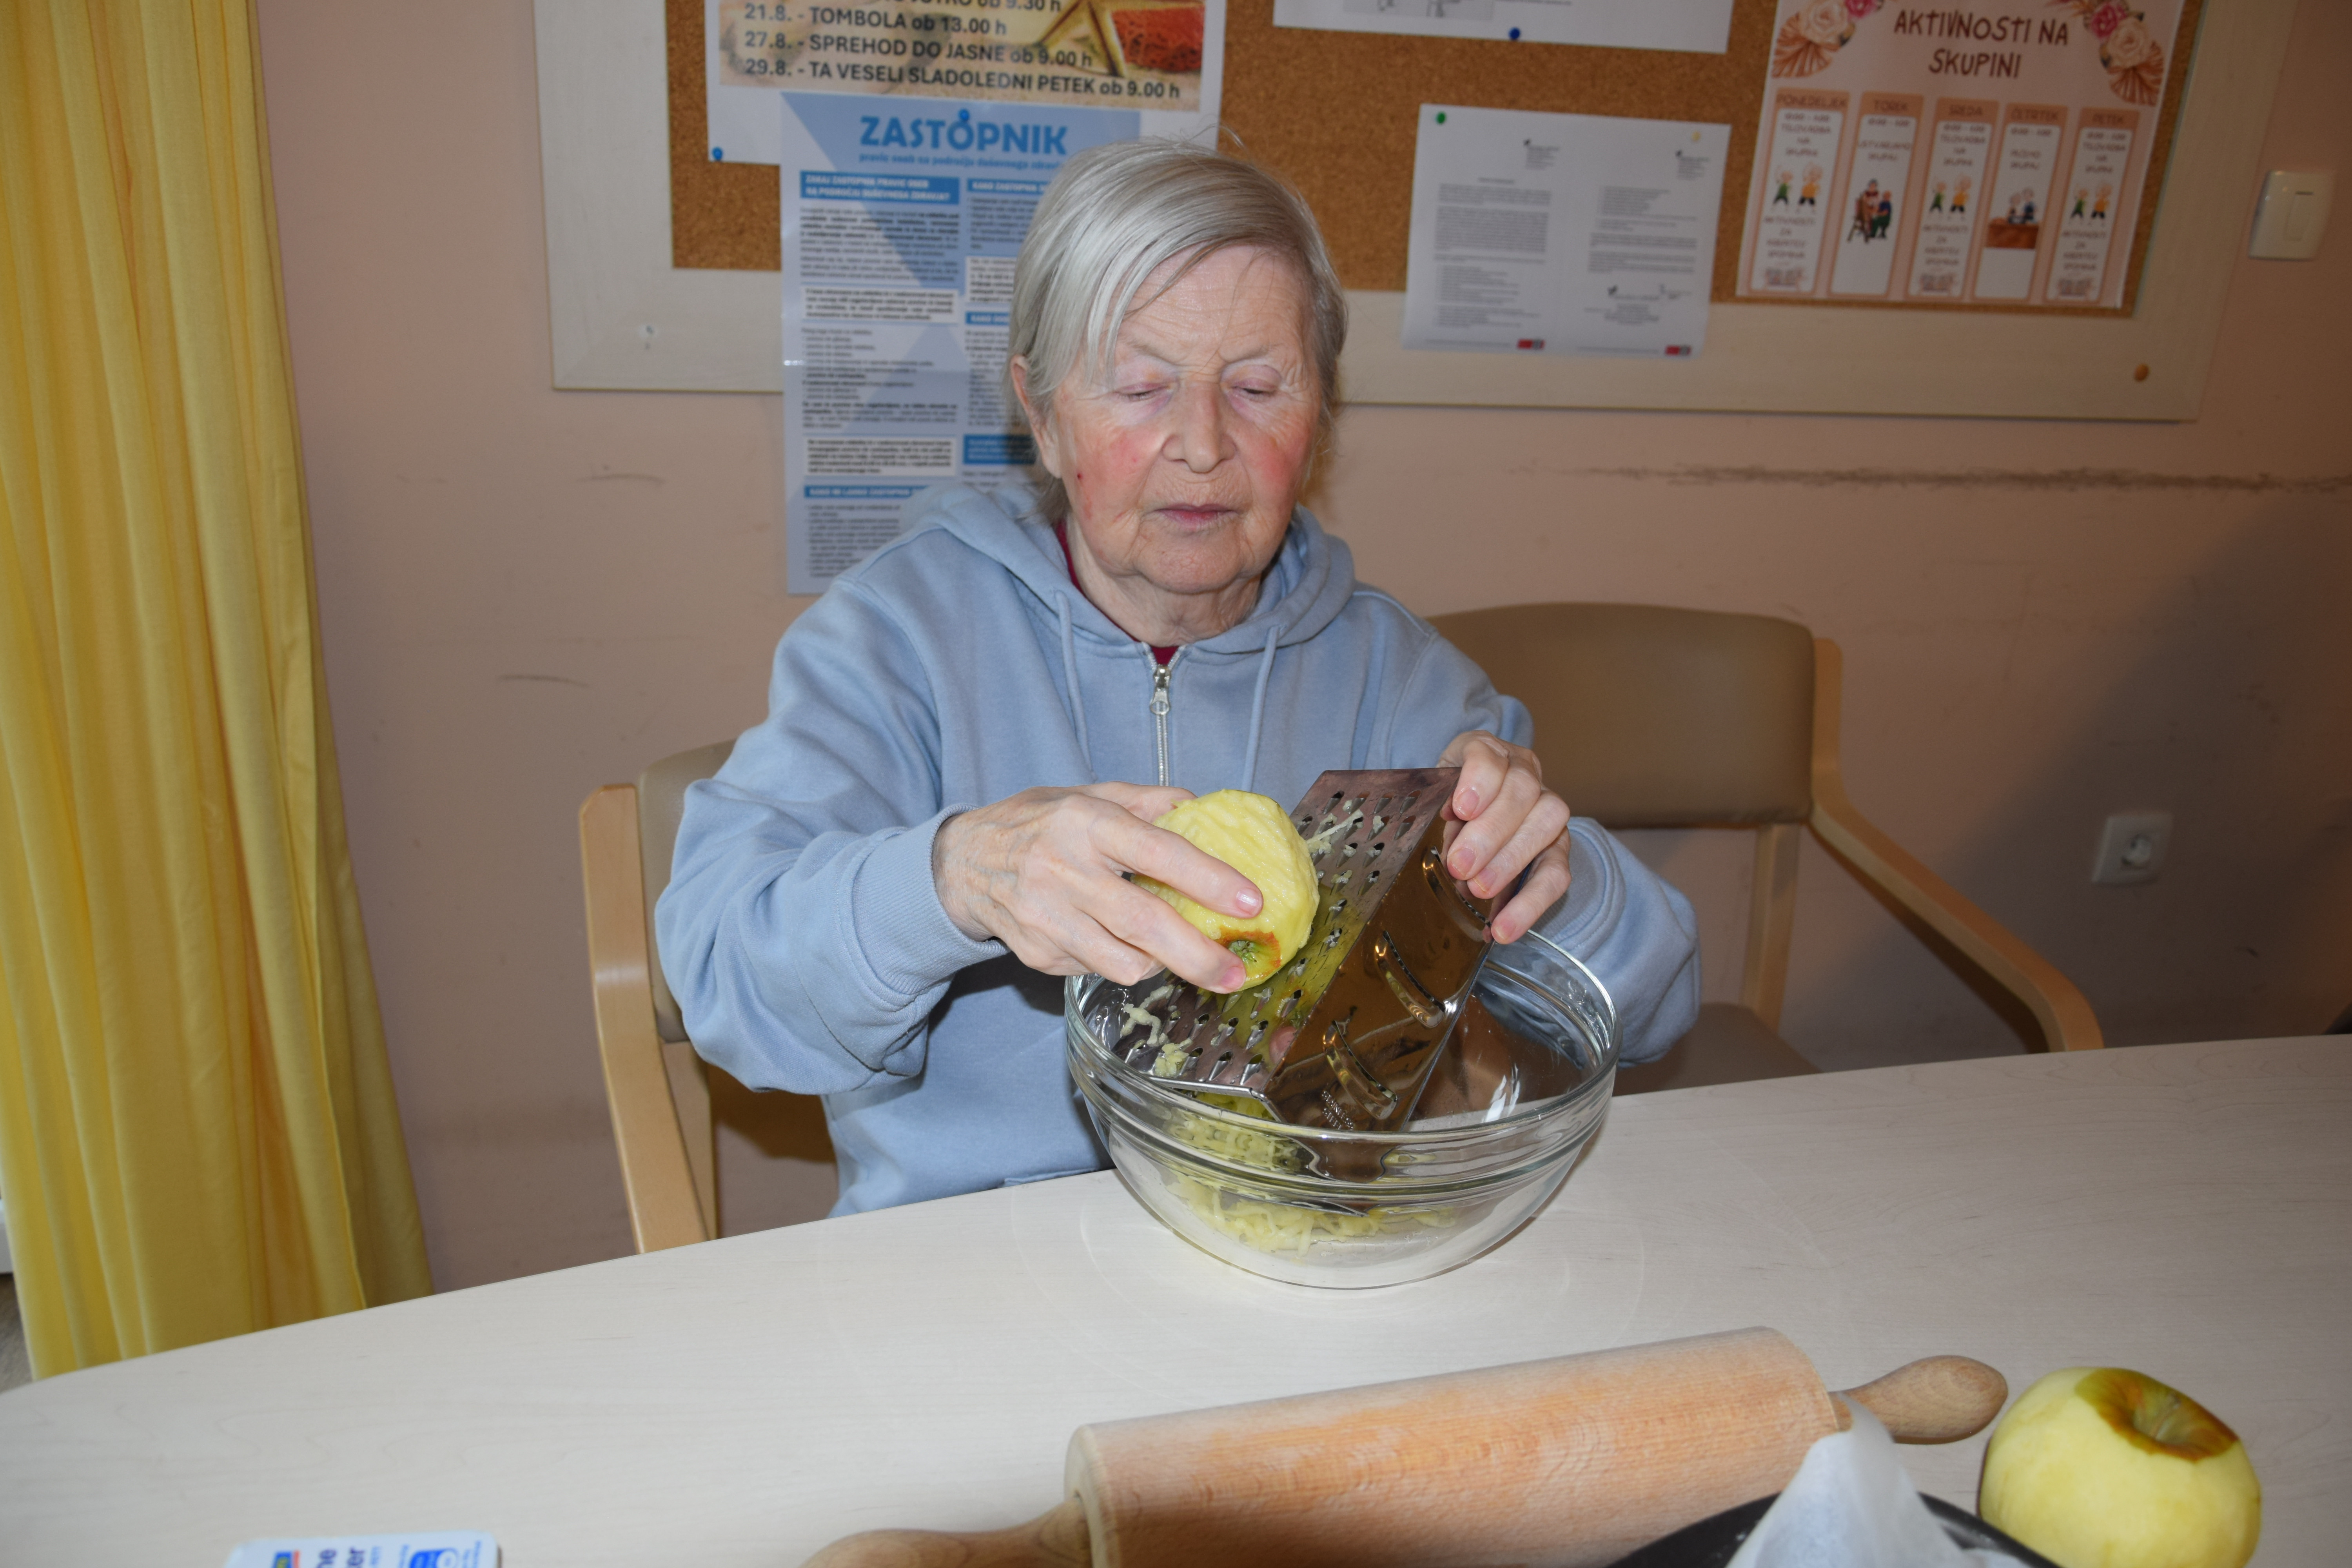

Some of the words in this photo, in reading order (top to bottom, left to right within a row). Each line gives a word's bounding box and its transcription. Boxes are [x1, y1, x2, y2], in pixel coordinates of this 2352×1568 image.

[746, 5, 792, 21] 21.8.
[810, 7, 906, 29] TOMBOLA
[912, 15, 935, 30] ob
[941, 17, 990, 34] 13.00
[996, 20, 1006, 34] h
[1894, 9, 2031, 43] AKTIVNOSTI
[2038, 18, 2069, 46] NA
[746, 31, 792, 49] 27.8.
[809, 34, 906, 55] SPREHOD
[912, 40, 941, 57] DO
[947, 43, 1005, 60] JASNE
[1011, 47, 1033, 64] ob
[1039, 49, 1076, 66] 9.00
[1082, 51, 1092, 67] h
[1928, 47, 2022, 79] SKUPINI
[746, 59, 792, 76] 29.8.
[809, 62, 832, 78] TA
[836, 64, 902, 83] VESELI
[908, 67, 1032, 90] SLADOLEDNI
[1038, 76, 1094, 94] PETEK
[1100, 80, 1122, 95] ob
[1127, 80, 1164, 97] 9.00
[1170, 82, 1180, 98] h
[860, 116, 1068, 155] ZASTOPNIK
[1322, 1091, 1355, 1131] STAINLESS
